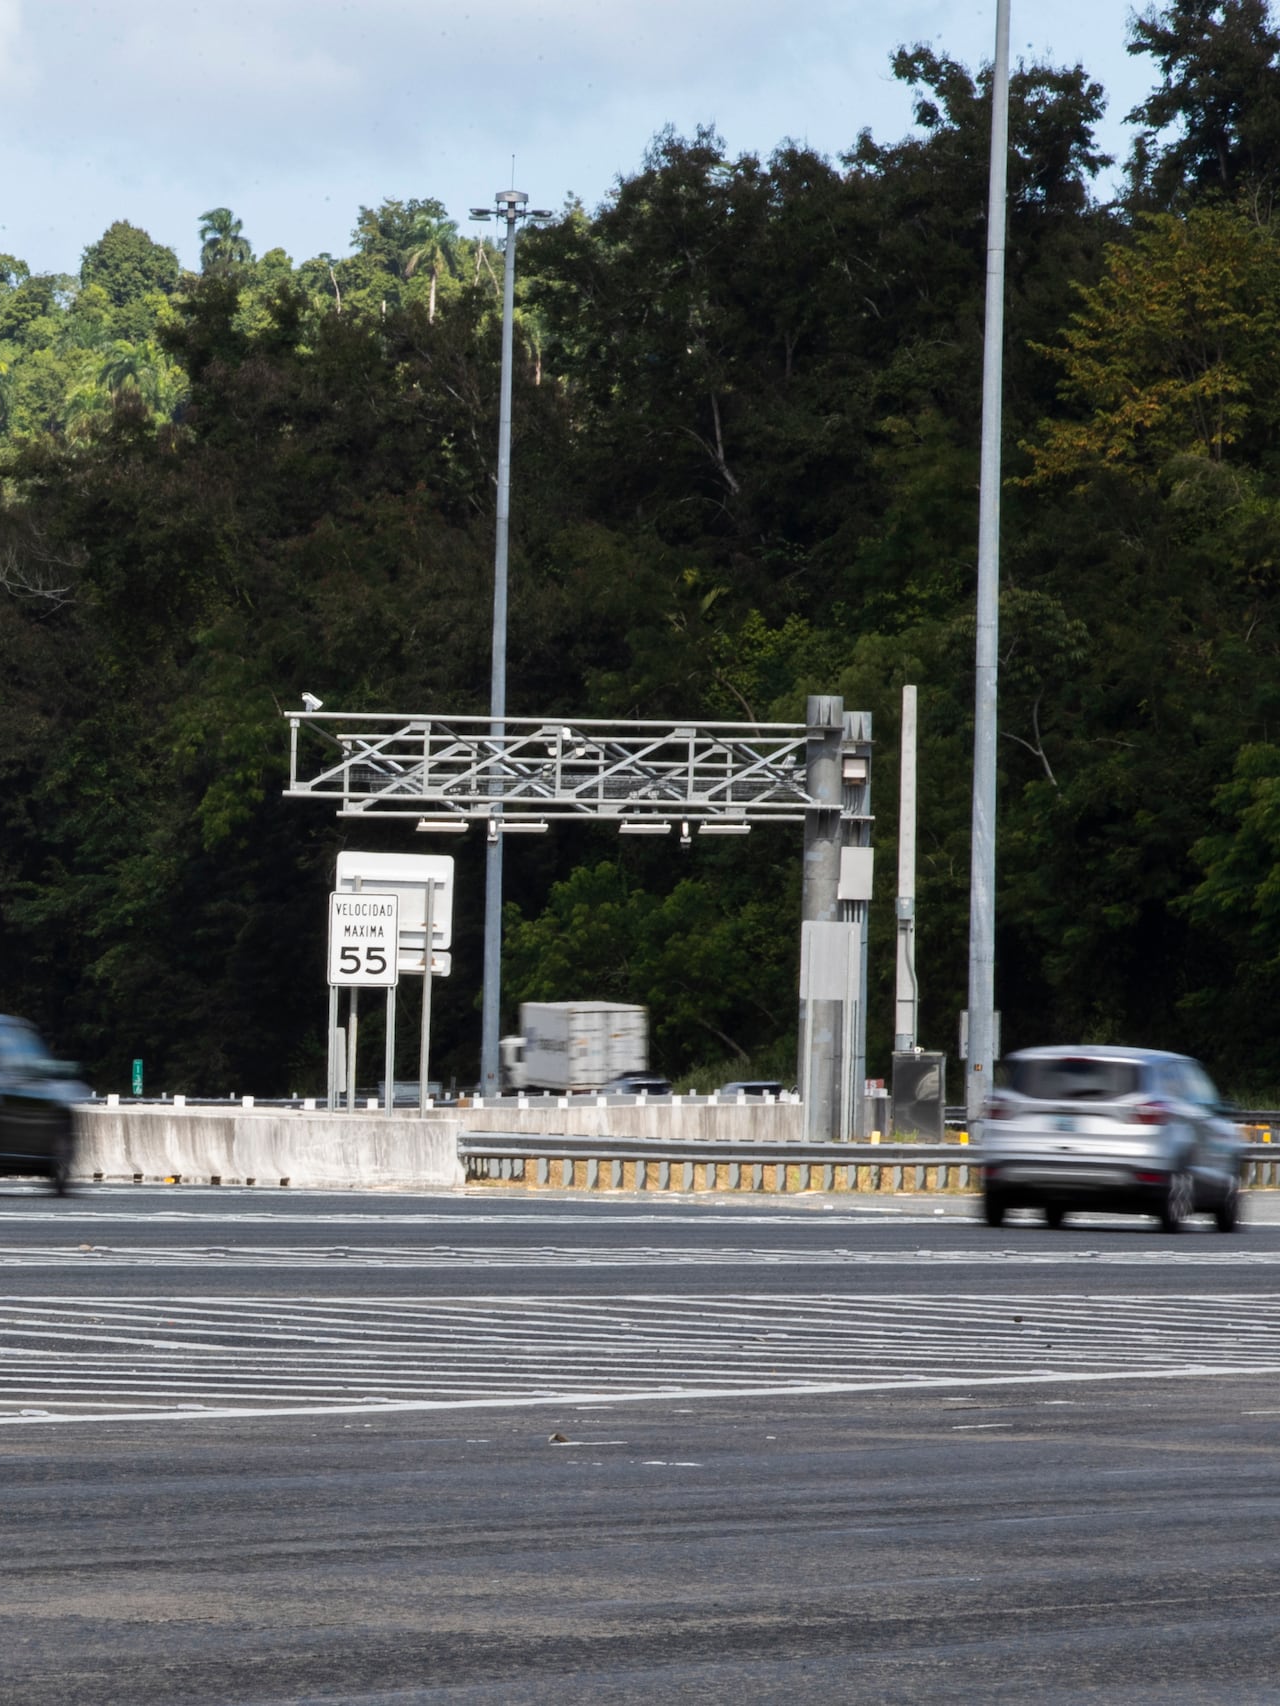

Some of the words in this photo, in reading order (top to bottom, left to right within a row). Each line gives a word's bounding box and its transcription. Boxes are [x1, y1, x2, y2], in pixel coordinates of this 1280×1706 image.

[336, 903, 393, 917] VELOCIDAD
[344, 925, 384, 938] MAXIMA
[339, 946, 387, 975] 55
